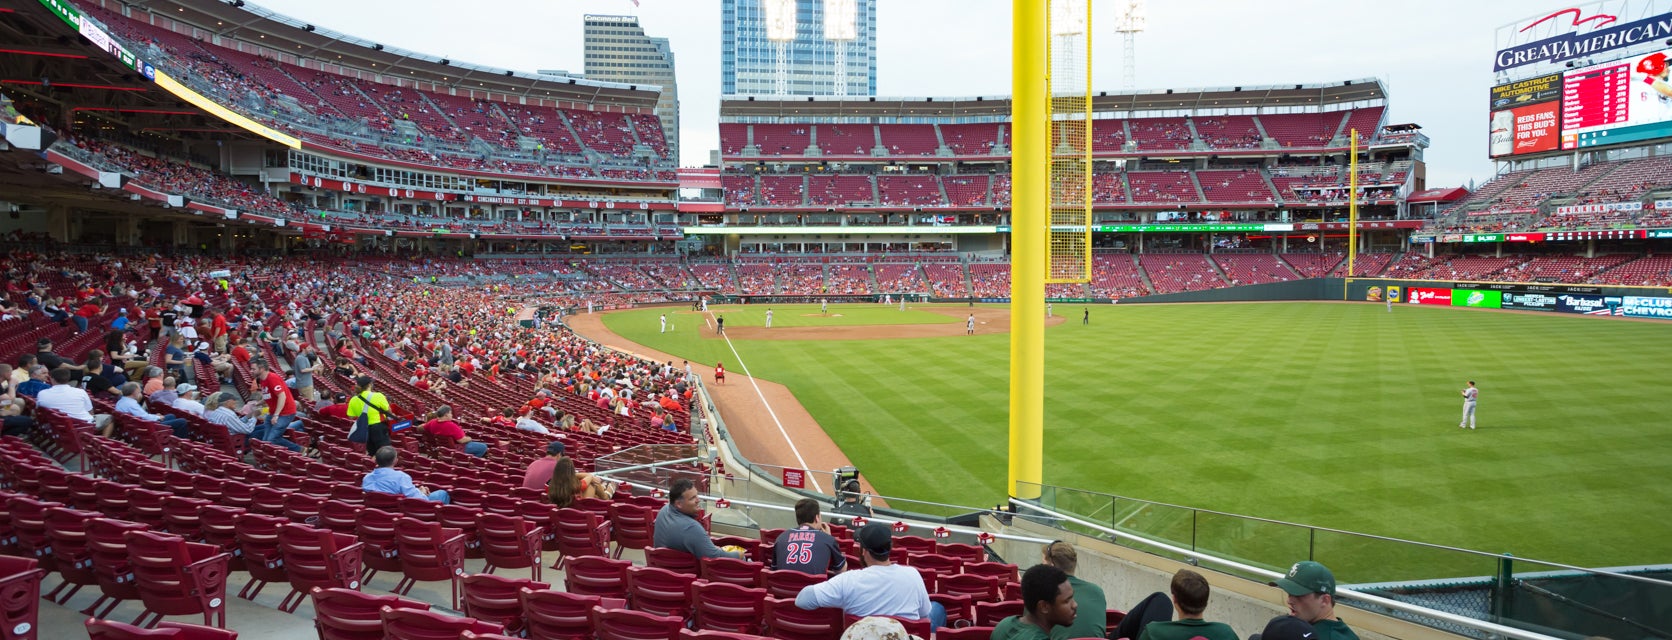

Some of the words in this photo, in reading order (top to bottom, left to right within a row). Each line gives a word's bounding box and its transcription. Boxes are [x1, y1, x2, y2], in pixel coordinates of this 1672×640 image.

[1497, 41, 1559, 69] GREAT
[1554, 18, 1672, 60] AMERICAN
[1493, 85, 1511, 93] MIKE
[1513, 75, 1559, 89] CASTRUCCI
[1500, 83, 1550, 98] AUTOMOTIVE
[1517, 115, 1535, 123] REDS
[1517, 123, 1533, 131] THIS
[1533, 119, 1555, 129] BUD'S
[1517, 131, 1530, 139] FOR
[1531, 128, 1548, 137] YOU.
[478, 196, 503, 204] CINCINNATI
[1566, 296, 1604, 307] Barbasol
[786, 542, 813, 564] 25
